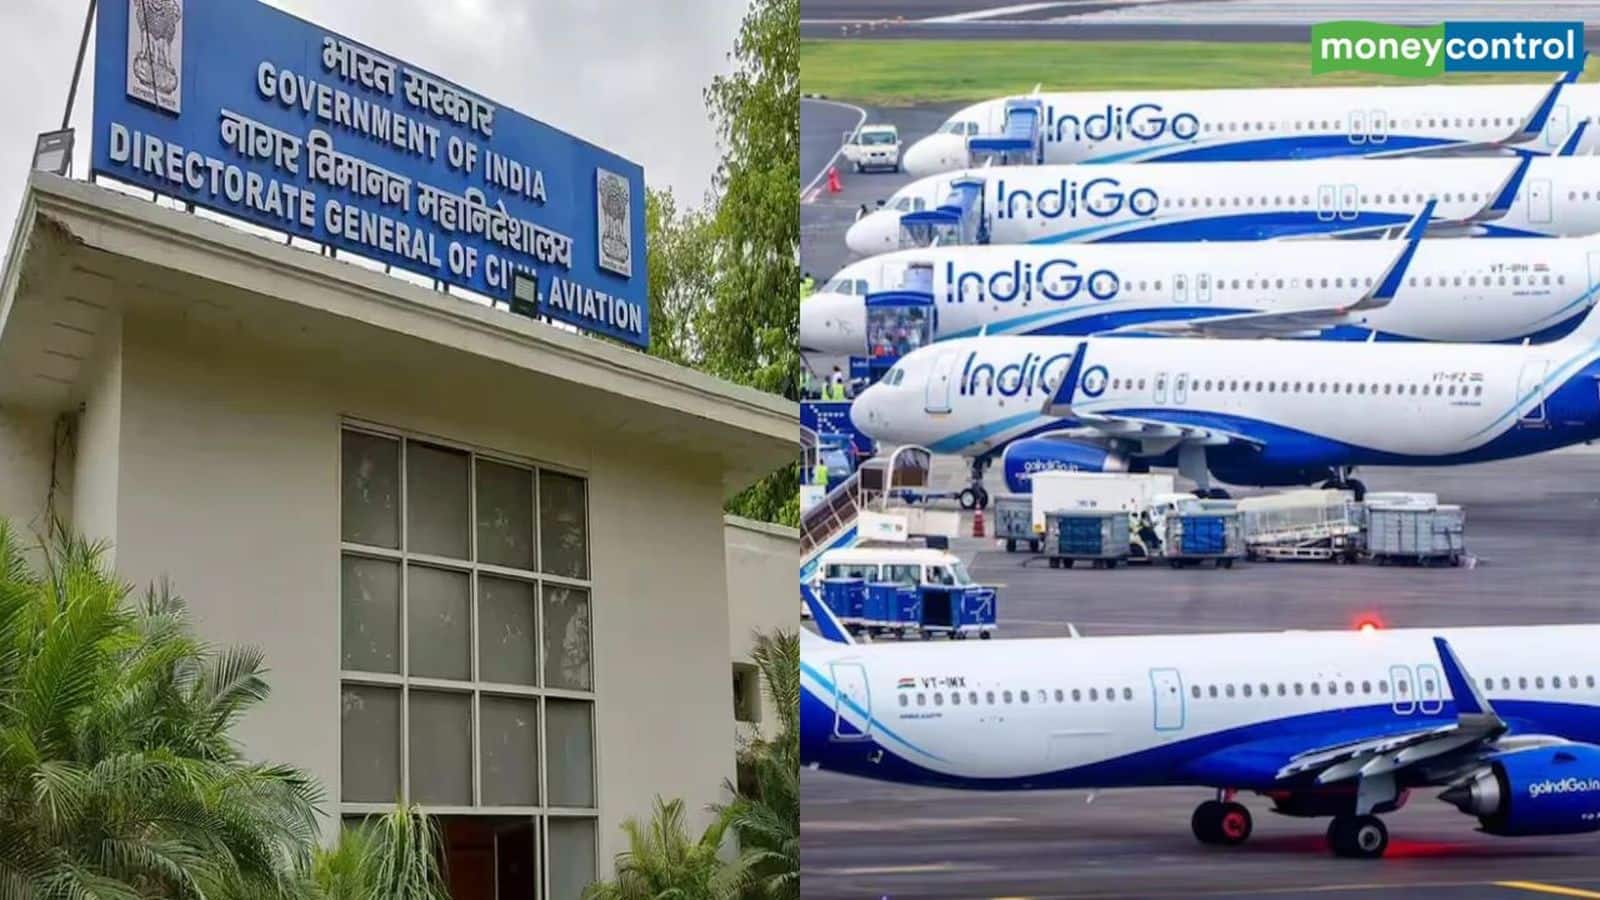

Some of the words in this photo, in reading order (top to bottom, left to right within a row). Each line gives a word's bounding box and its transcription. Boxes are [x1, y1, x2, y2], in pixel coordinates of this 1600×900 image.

[322, 36, 396, 94] भारत
[403, 68, 496, 136] सरकार
[257, 61, 441, 159] GOVERNMENT
[448, 136, 478, 172] OF
[485, 150, 547, 203] INDIA
[1047, 104, 1199, 141] IndiGo
[221, 108, 302, 174] नागर
[307, 129, 412, 212] विमानन
[417, 182, 573, 269] महानिदेशालय
[997, 178, 1159, 219] IndiGo
[110, 122, 316, 227] DIRECTORATE
[324, 200, 442, 268] GENERAL
[449, 241, 478, 278] OF
[549, 275, 642, 335] AVIATION
[947, 259, 1119, 302] IndiGo
[921, 676, 966, 689] VT-IMX
